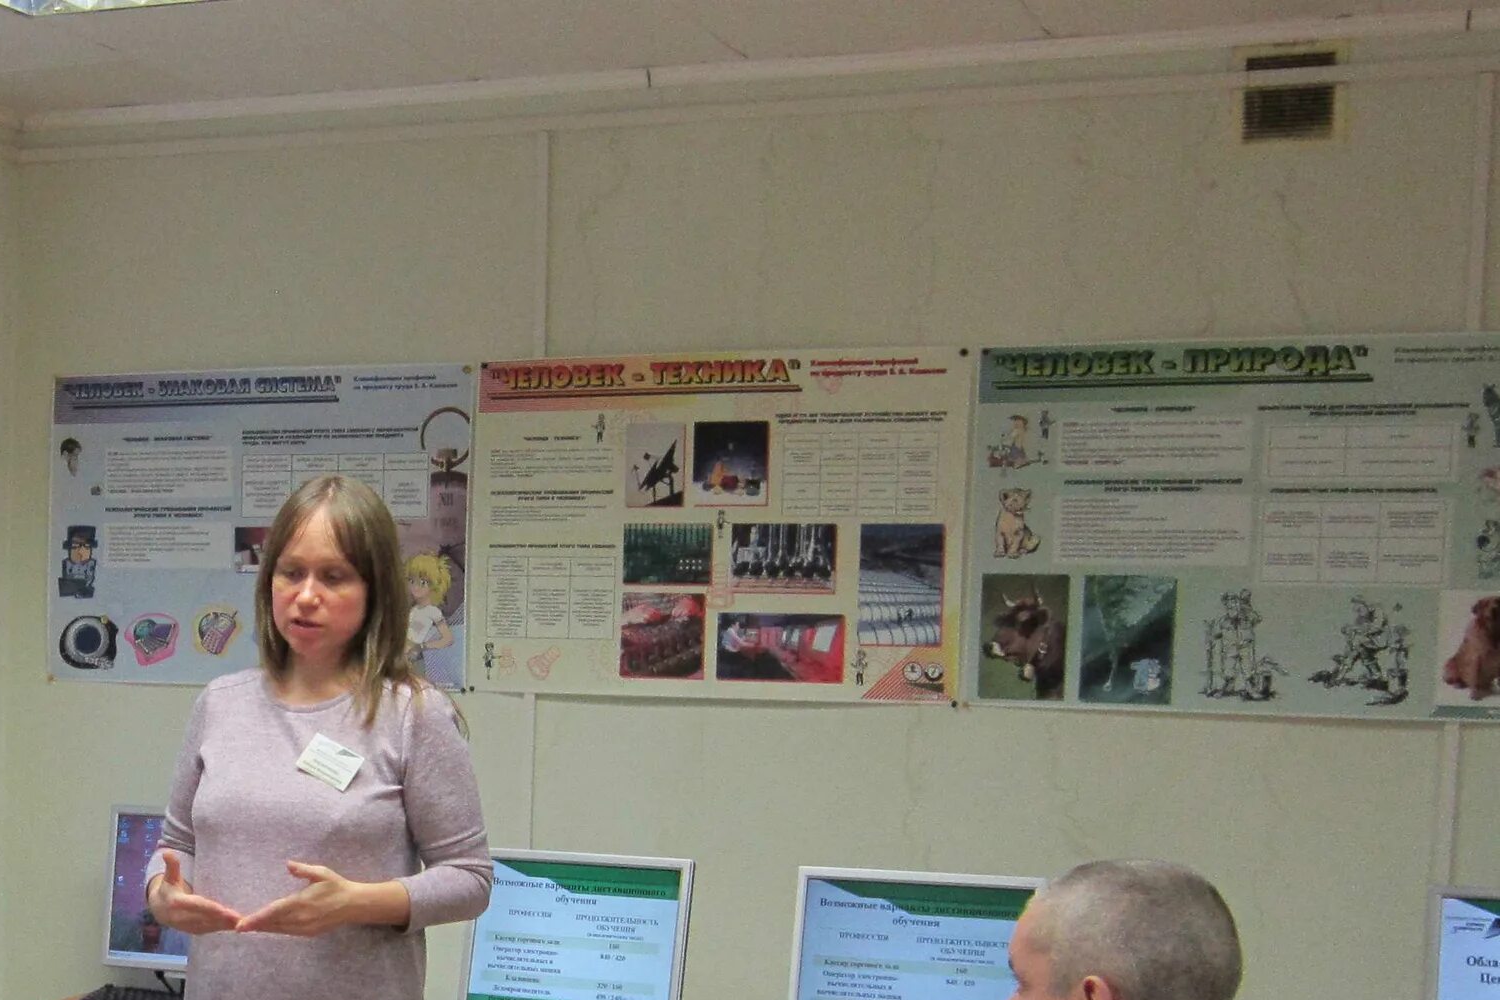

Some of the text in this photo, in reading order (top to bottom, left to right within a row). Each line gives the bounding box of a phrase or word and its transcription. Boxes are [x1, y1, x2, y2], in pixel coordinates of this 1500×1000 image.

[994, 349, 1155, 377] "ЧЕЛОВЕК
[1182, 344, 1368, 376] ПРИРОДА"
[491, 362, 625, 390] "ЧЕЛОВЕК
[649, 358, 801, 385] ТЕХНИКА"
[158, 377, 251, 397] ЗНАКОВАЯ
[254, 374, 342, 394] СИСТЕМА"
[493, 877, 544, 889] Возможные
[544, 881, 590, 893] варианты
[555, 896, 598, 907] обучения
[820, 897, 878, 910] Возможные
[879, 901, 930, 914] варианты
[892, 916, 940, 928] обучения
